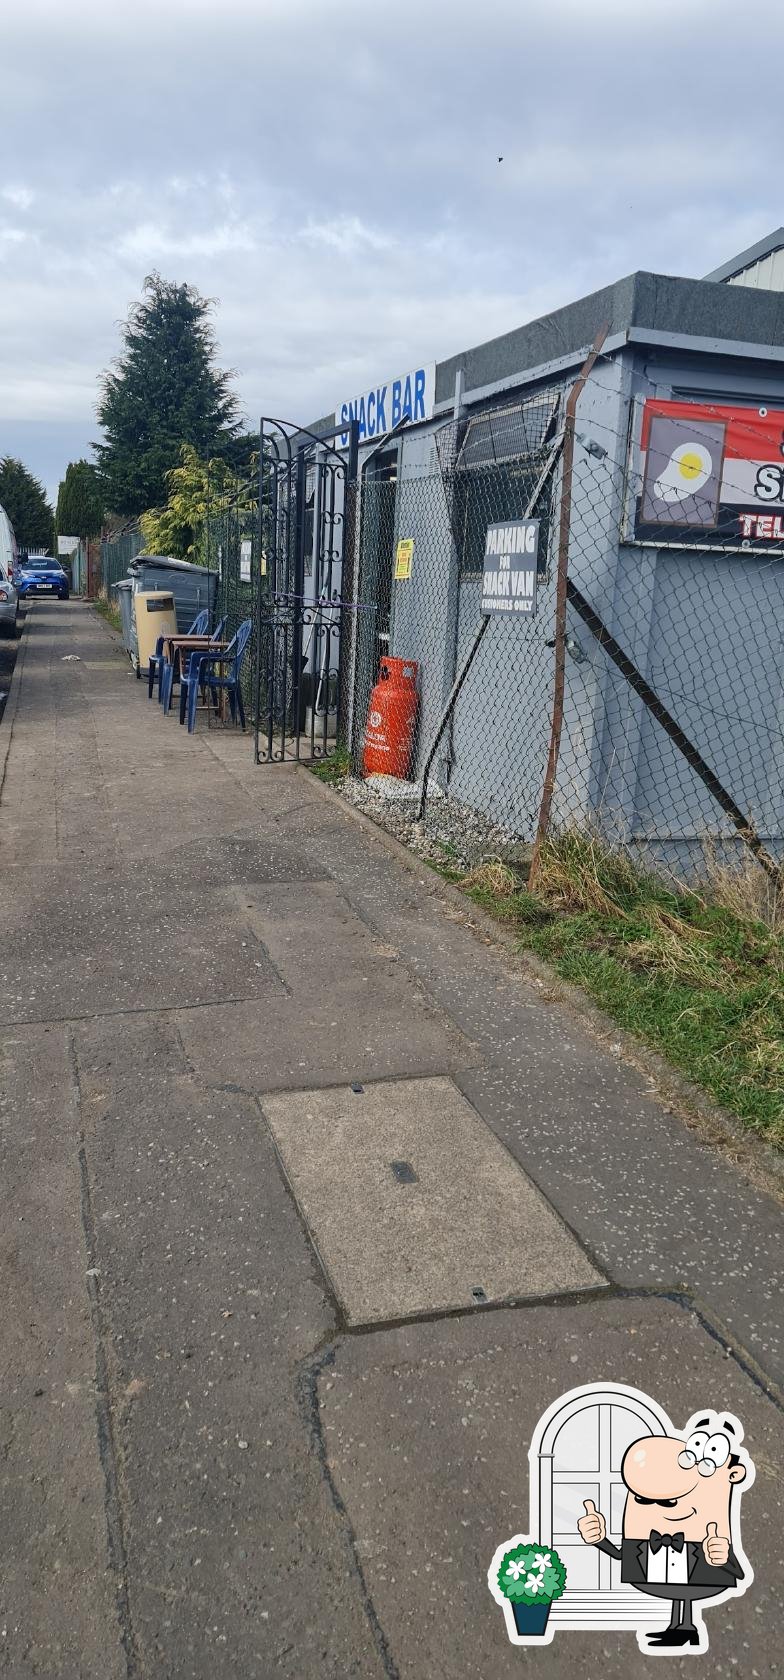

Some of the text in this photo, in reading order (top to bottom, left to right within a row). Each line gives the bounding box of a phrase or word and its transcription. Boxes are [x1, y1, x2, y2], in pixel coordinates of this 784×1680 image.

[341, 369, 426, 446] SNACK BAR
[754, 464, 784, 503] S
[486, 525, 536, 555] PARKING
[499, 555, 511, 570] FOR
[482, 570, 535, 597] SNACK VAN
[481, 598, 533, 612] CUSTOMERS ONLY
